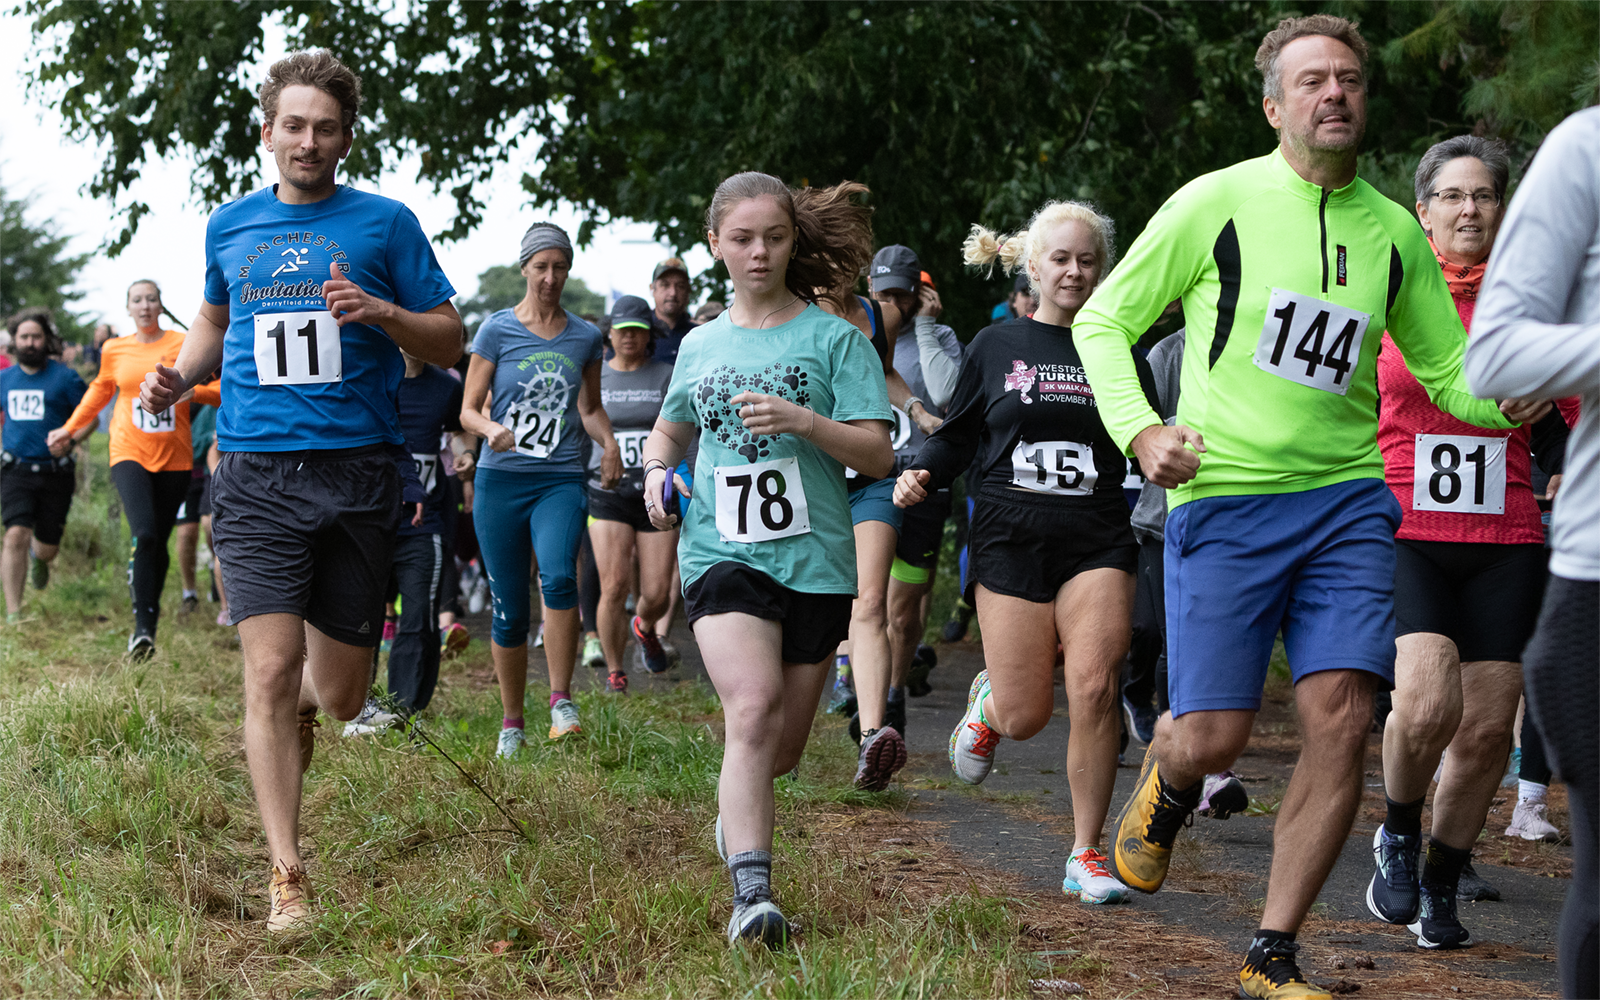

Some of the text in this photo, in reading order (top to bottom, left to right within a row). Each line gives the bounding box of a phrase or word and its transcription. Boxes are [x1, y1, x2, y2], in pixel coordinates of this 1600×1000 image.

[238, 231, 350, 278] MANCHESTER
[267, 319, 319, 377] 11
[517, 351, 578, 373] NEWBURYPORT
[1270, 300, 1359, 385] 144
[12, 395, 41, 416] 142
[1040, 393, 1087, 405] NOVEMBER
[510, 410, 558, 451] 124
[1025, 448, 1085, 489] 15
[1429, 443, 1486, 505] 81
[725, 469, 793, 535] 78
